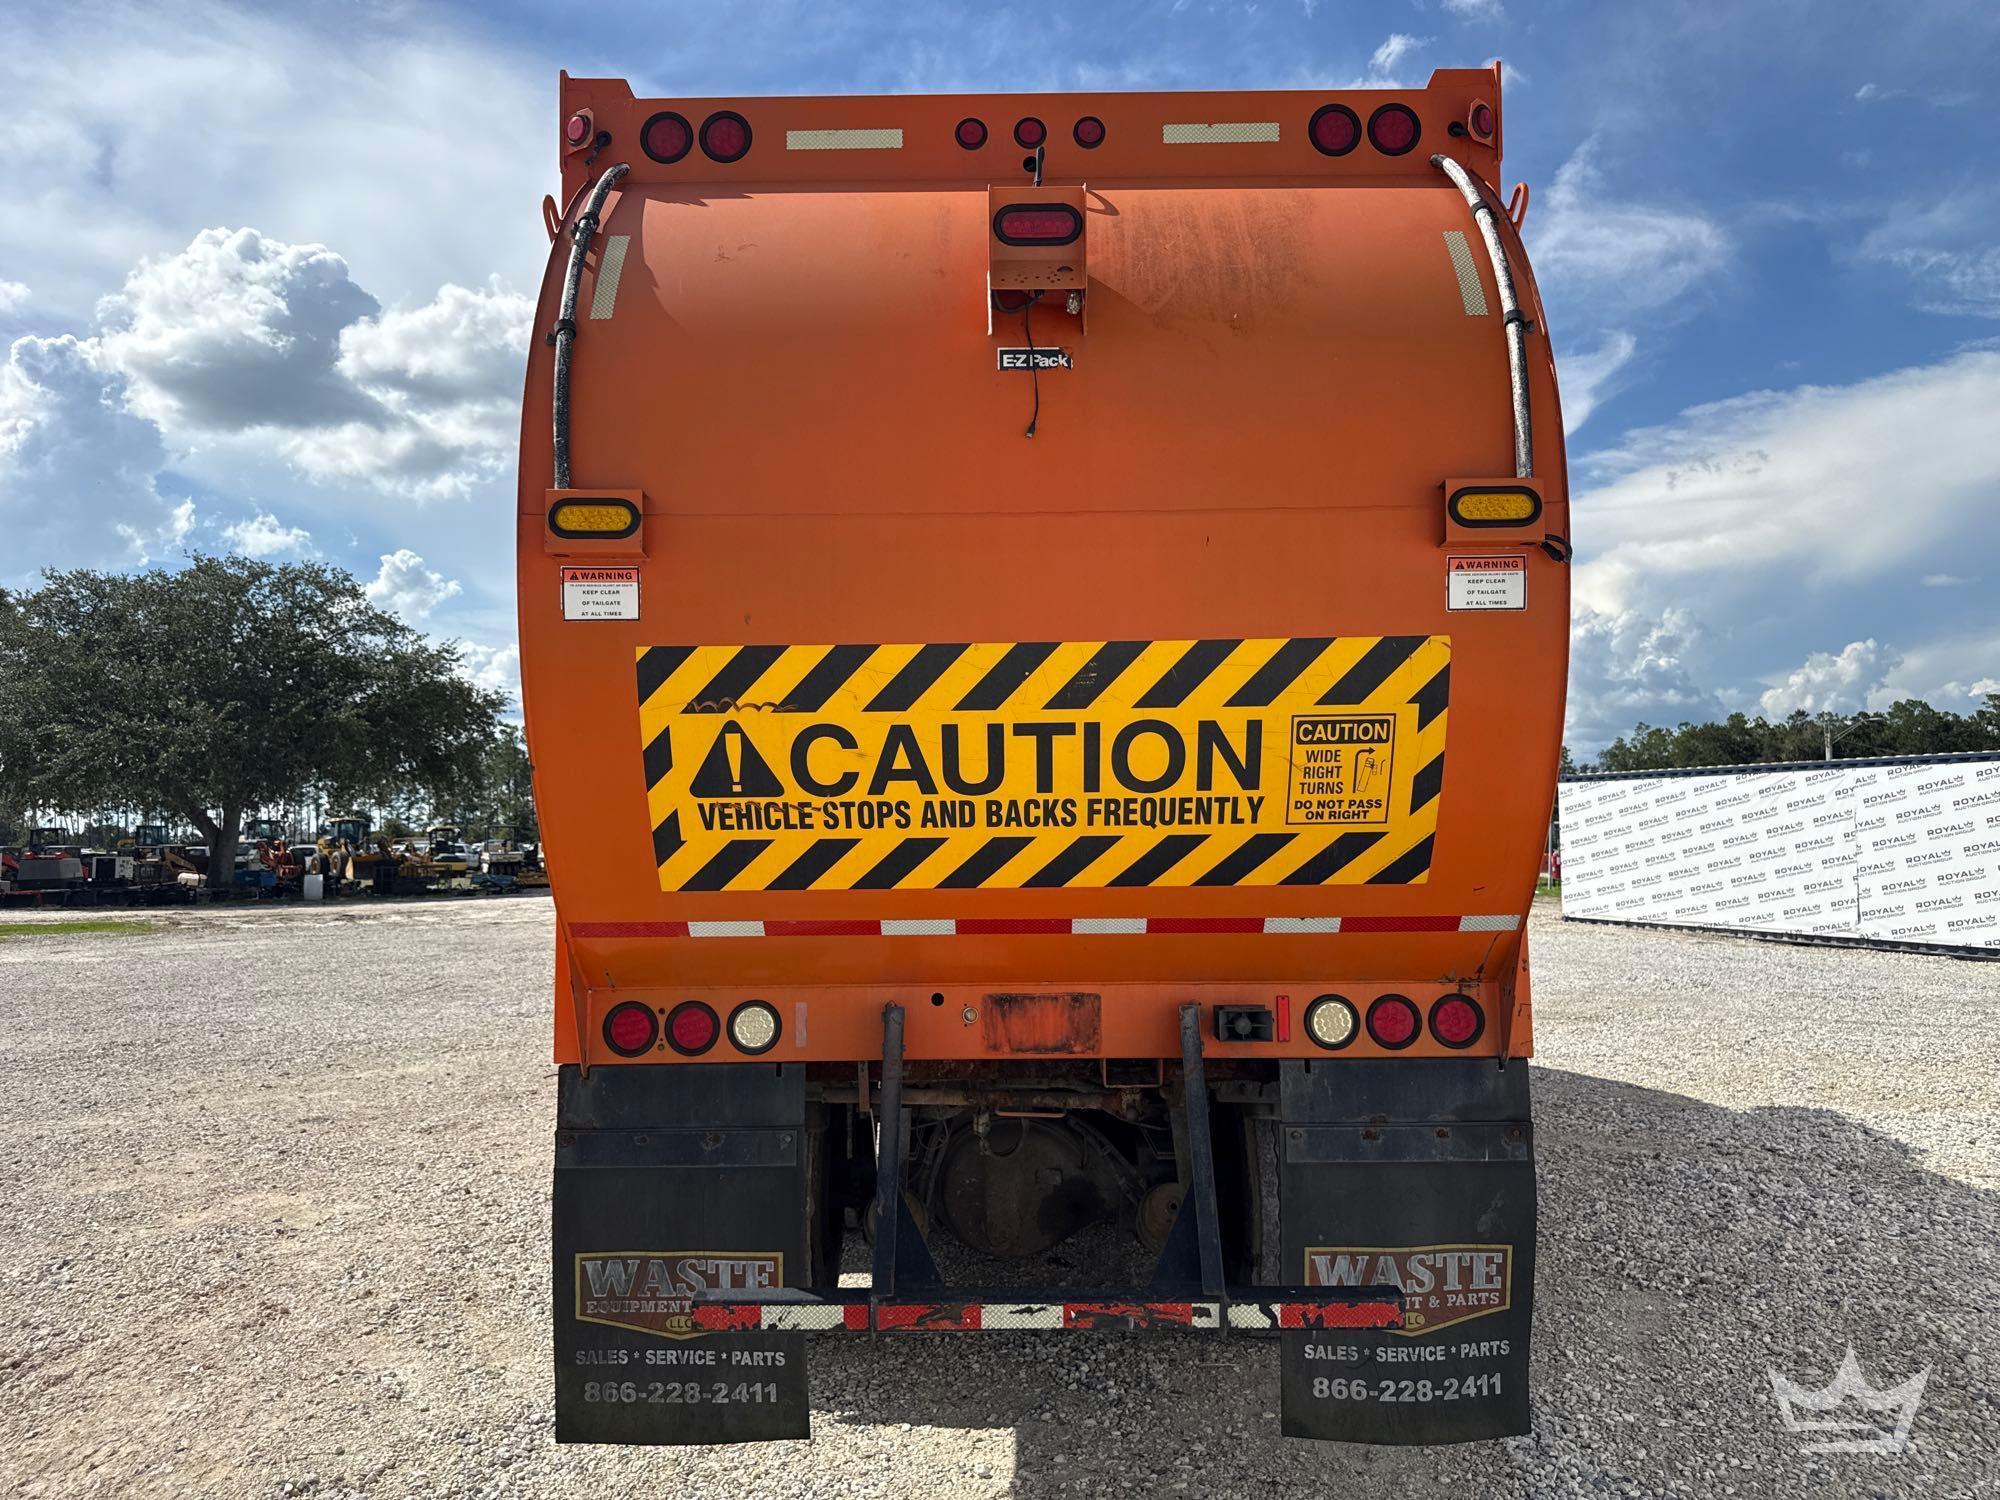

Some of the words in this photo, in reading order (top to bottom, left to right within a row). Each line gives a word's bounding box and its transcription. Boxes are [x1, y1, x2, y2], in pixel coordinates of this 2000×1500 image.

[1466, 561, 1519, 569] WARNING
[581, 572, 632, 580] WARNING
[1299, 722, 1388, 741] CAUTION
[790, 718, 1263, 798] CAUTION
[1305, 750, 1342, 762] WIDE
[1303, 766, 1342, 778] RIGHT
[1806, 771, 1834, 782] ROYAL
[1299, 782, 1344, 794] TURNS
[1694, 782, 1719, 792] ROYAL
[1758, 782, 1786, 795] ROYAL
[1918, 778, 1954, 791] ROYAL
[1656, 794, 1678, 804] ROYAL
[1716, 796, 1742, 806] ROYAL
[1787, 797, 1816, 808] ROYAL
[1863, 792, 1897, 804] ROYAL
[1953, 794, 1991, 806] ROYAL
[1294, 800, 1312, 810] DO
[1316, 800, 1344, 810] NOT
[1348, 799, 1382, 809] PASS
[697, 801, 815, 831] VEHICLE
[823, 800, 912, 830] STOPS
[920, 800, 976, 828] AND
[986, 798, 1077, 828] BACKS
[1087, 795, 1265, 830] FREQUENTLY
[1305, 811, 1324, 820] ON
[1328, 810, 1369, 820] RIGHT
[1676, 807, 1700, 817] ROYAL
[1742, 809, 1770, 820] ROYAL
[1896, 807, 1932, 819] ROYAL
[1813, 812, 1844, 824] ROYAL
[1700, 820, 1726, 830] ROYAL
[1766, 824, 1796, 834] ROYAL
[1927, 824, 1964, 836] ROYAL
[1662, 830, 1685, 840] ROYAL
[1723, 834, 1750, 845] ROYAL
[1795, 839, 1824, 850] ROYAL
[1872, 836, 1906, 848] ROYAL
[1964, 840, 2000, 852] ROYAL
[1682, 846, 1708, 854] ROYAL
[1750, 848, 1778, 859] ROYAL
[1646, 853, 1669, 864] ROYAL
[1707, 859, 1734, 868] ROYAL
[1822, 854, 1853, 866] ROYAL
[1906, 852, 1942, 864] ROYAL
[1668, 868, 1693, 878] ROYAL
[1775, 865, 1804, 875] ROYAL
[1937, 870, 1975, 881] ROYAL
[1731, 874, 1758, 884] ROYAL
[1690, 882, 1716, 892] ROYAL
[1804, 880, 1834, 890] ROYAL
[1882, 880, 1916, 891] ROYAL
[1652, 890, 1676, 900] ROYAL
[1758, 890, 1786, 899] ROYAL
[1716, 898, 1742, 907] ROYAL
[1916, 898, 1952, 908] ROYAL
[1676, 905, 1701, 914] ROYAL
[1784, 906, 1813, 916] ROYAL
[1862, 907, 1896, 917] ROYAL
[1739, 914, 1766, 923] ROYAL
[1948, 917, 1986, 928] ROYAL
[1812, 922, 1842, 932] ROYAL
[1892, 926, 1926, 936] ROYAL
[581, 1259, 775, 1298] WASTE
[1311, 1252, 1503, 1294] WASTE
[1428, 1295, 1440, 1308] &
[1447, 1292, 1500, 1306] PARTS
[586, 1300, 693, 1314] EQUIPMENT
[1304, 1344, 1358, 1361] SALES
[1376, 1346, 1446, 1362] SERVICE
[1460, 1340, 1511, 1358] PARTS
[575, 1350, 628, 1365] SALES
[645, 1350, 716, 1365] SERVICE
[731, 1351, 786, 1366] PARTS
[584, 1381, 778, 1404] 866-228-2411
[1312, 1372, 1502, 1402] 866-228-2411
